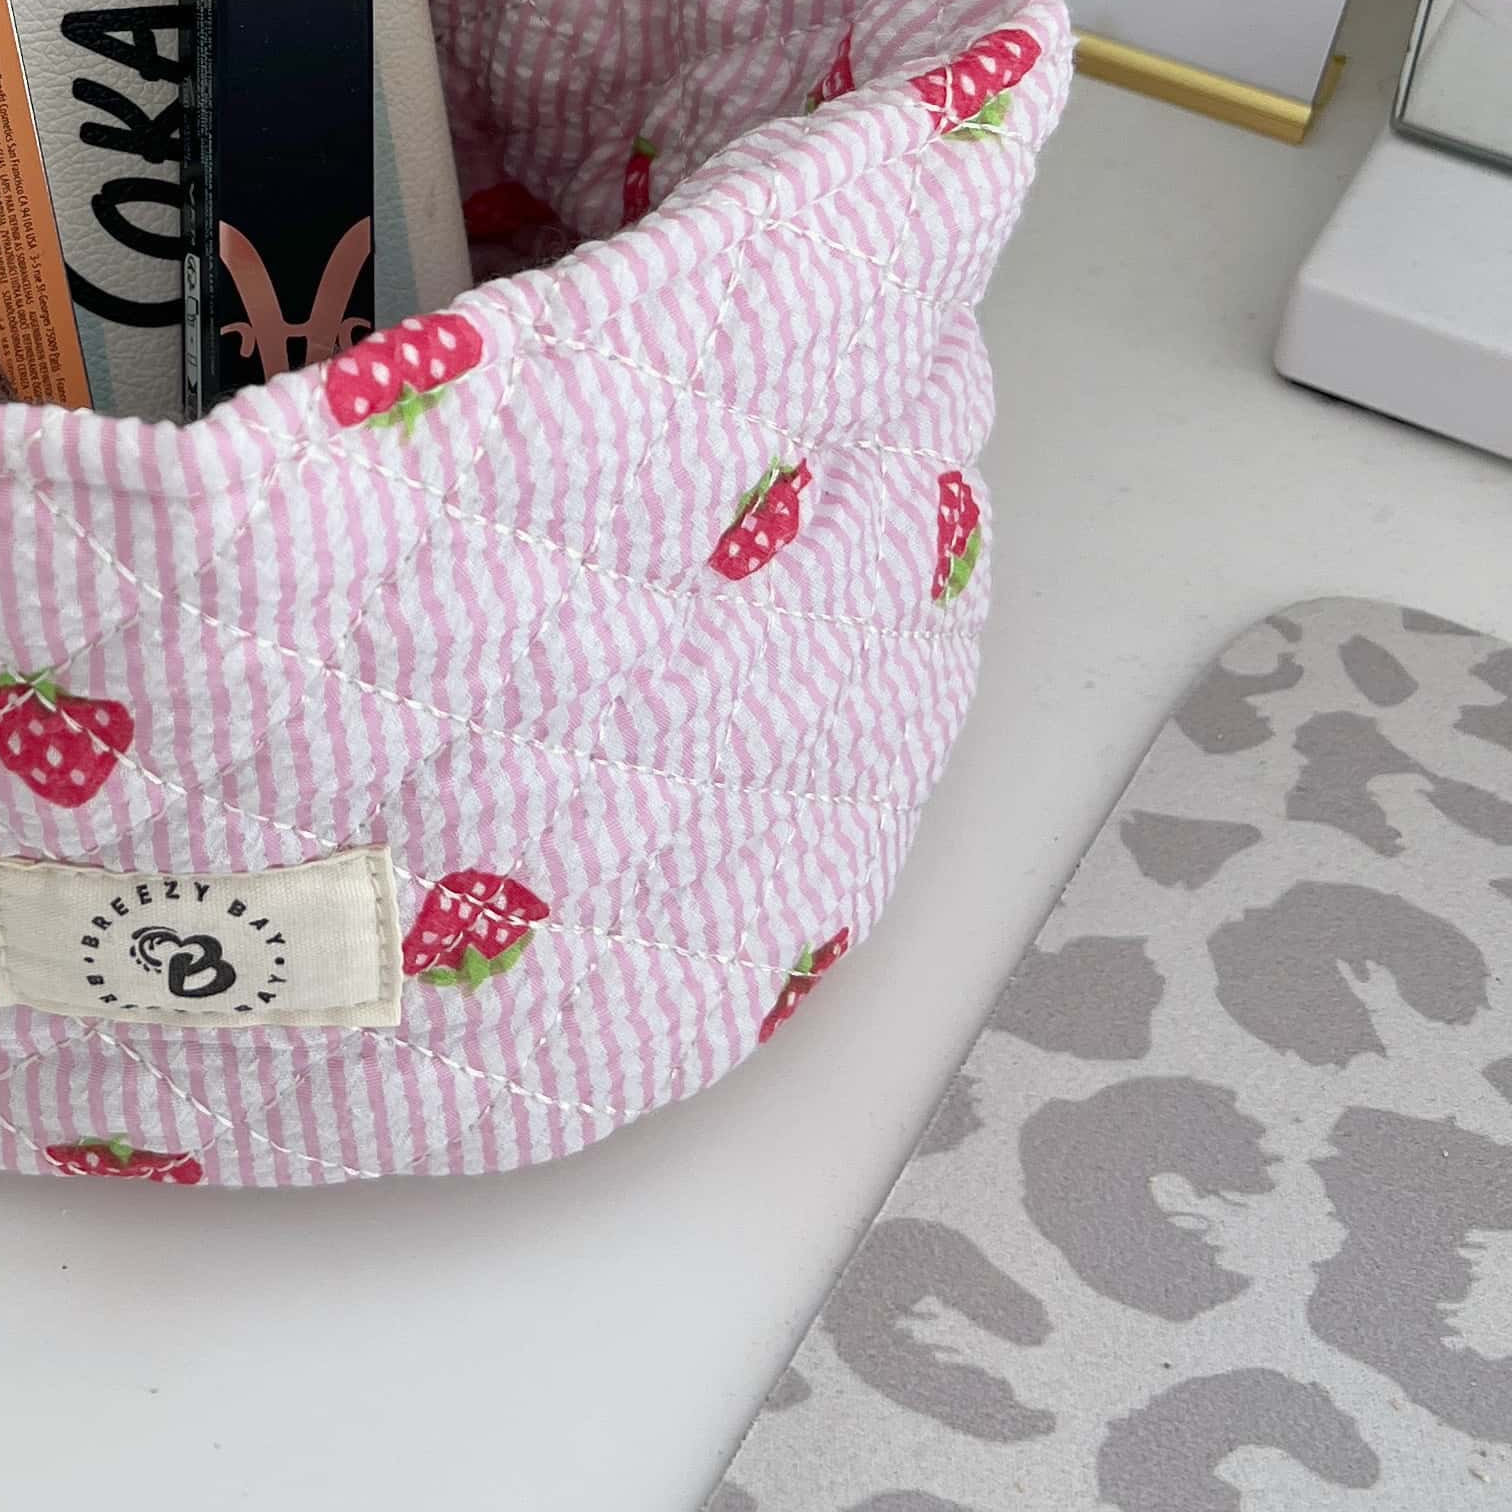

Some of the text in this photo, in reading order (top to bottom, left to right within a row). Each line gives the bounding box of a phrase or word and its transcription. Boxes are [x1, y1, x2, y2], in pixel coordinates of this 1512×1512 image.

[6, 142, 19, 158] San
[9, 158, 26, 195] Francisco
[17, 194, 29, 206] CA
[25, 232, 37, 249] USA
[81, 879, 287, 950] BREEZY BAY
